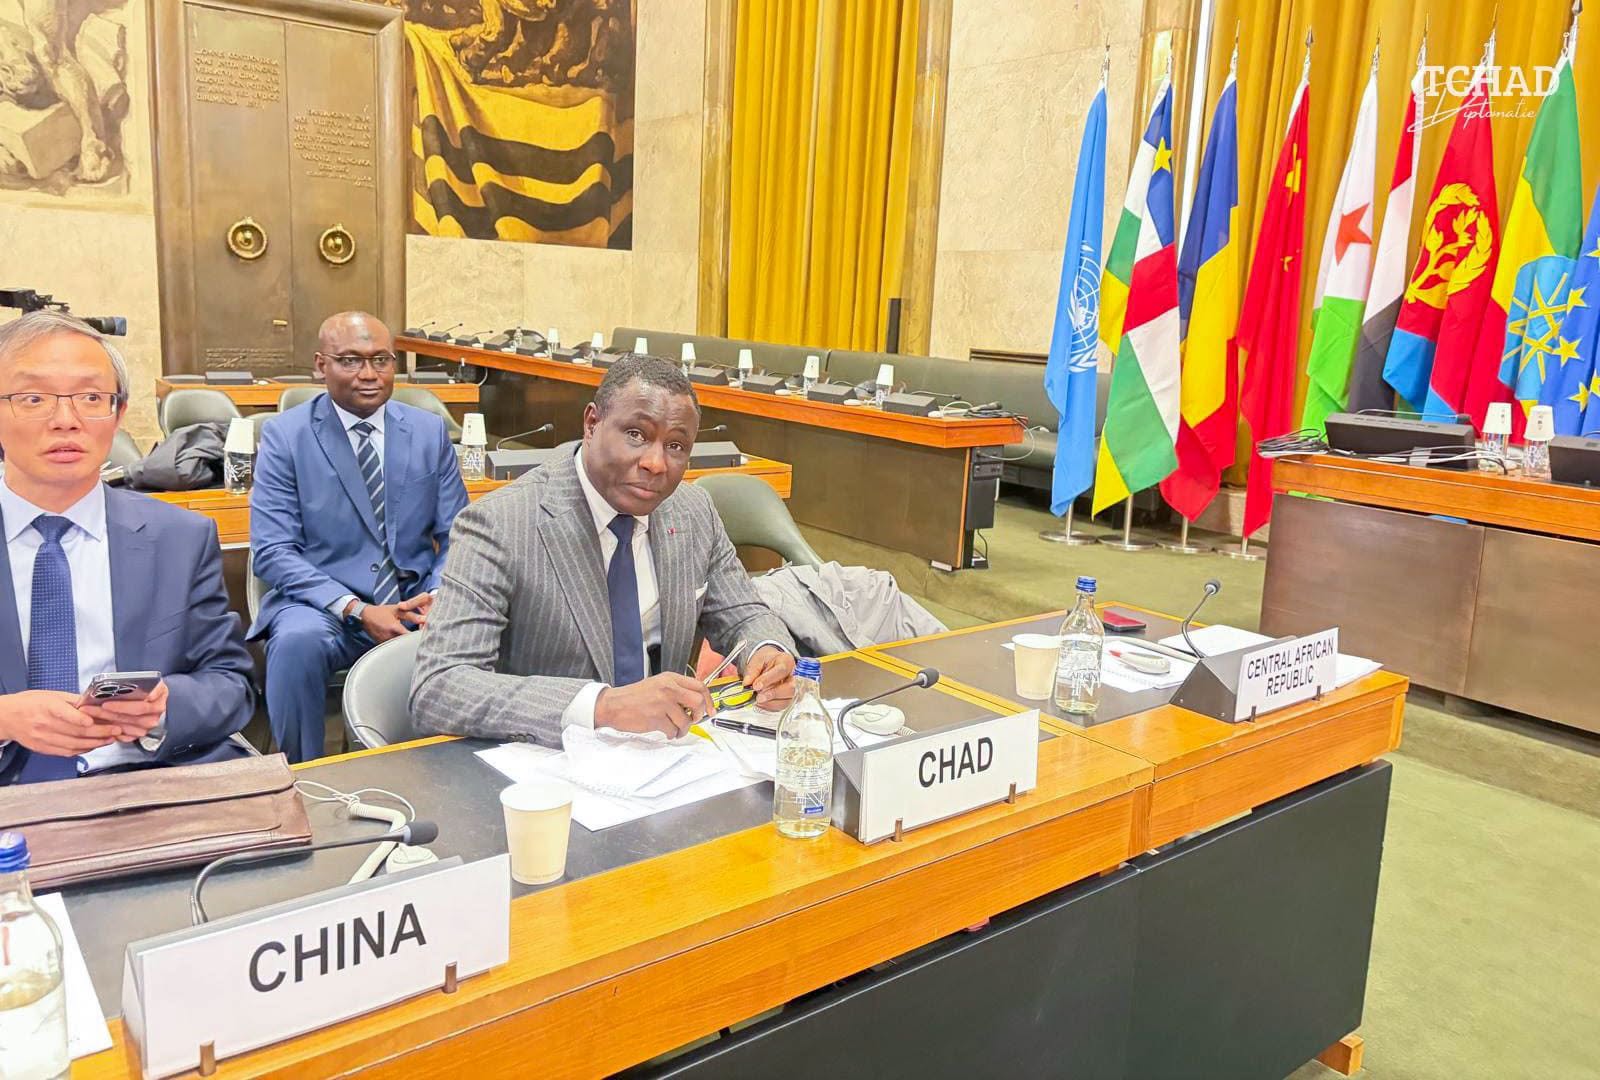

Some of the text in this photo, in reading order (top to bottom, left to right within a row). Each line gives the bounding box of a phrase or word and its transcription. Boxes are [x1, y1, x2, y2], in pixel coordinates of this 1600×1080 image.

[1247, 637, 1334, 680] CENTRAL AFRICAN
[1266, 665, 1314, 697] REPUBLIC
[918, 736, 994, 788] CHAD
[249, 902, 427, 993] CHINA
